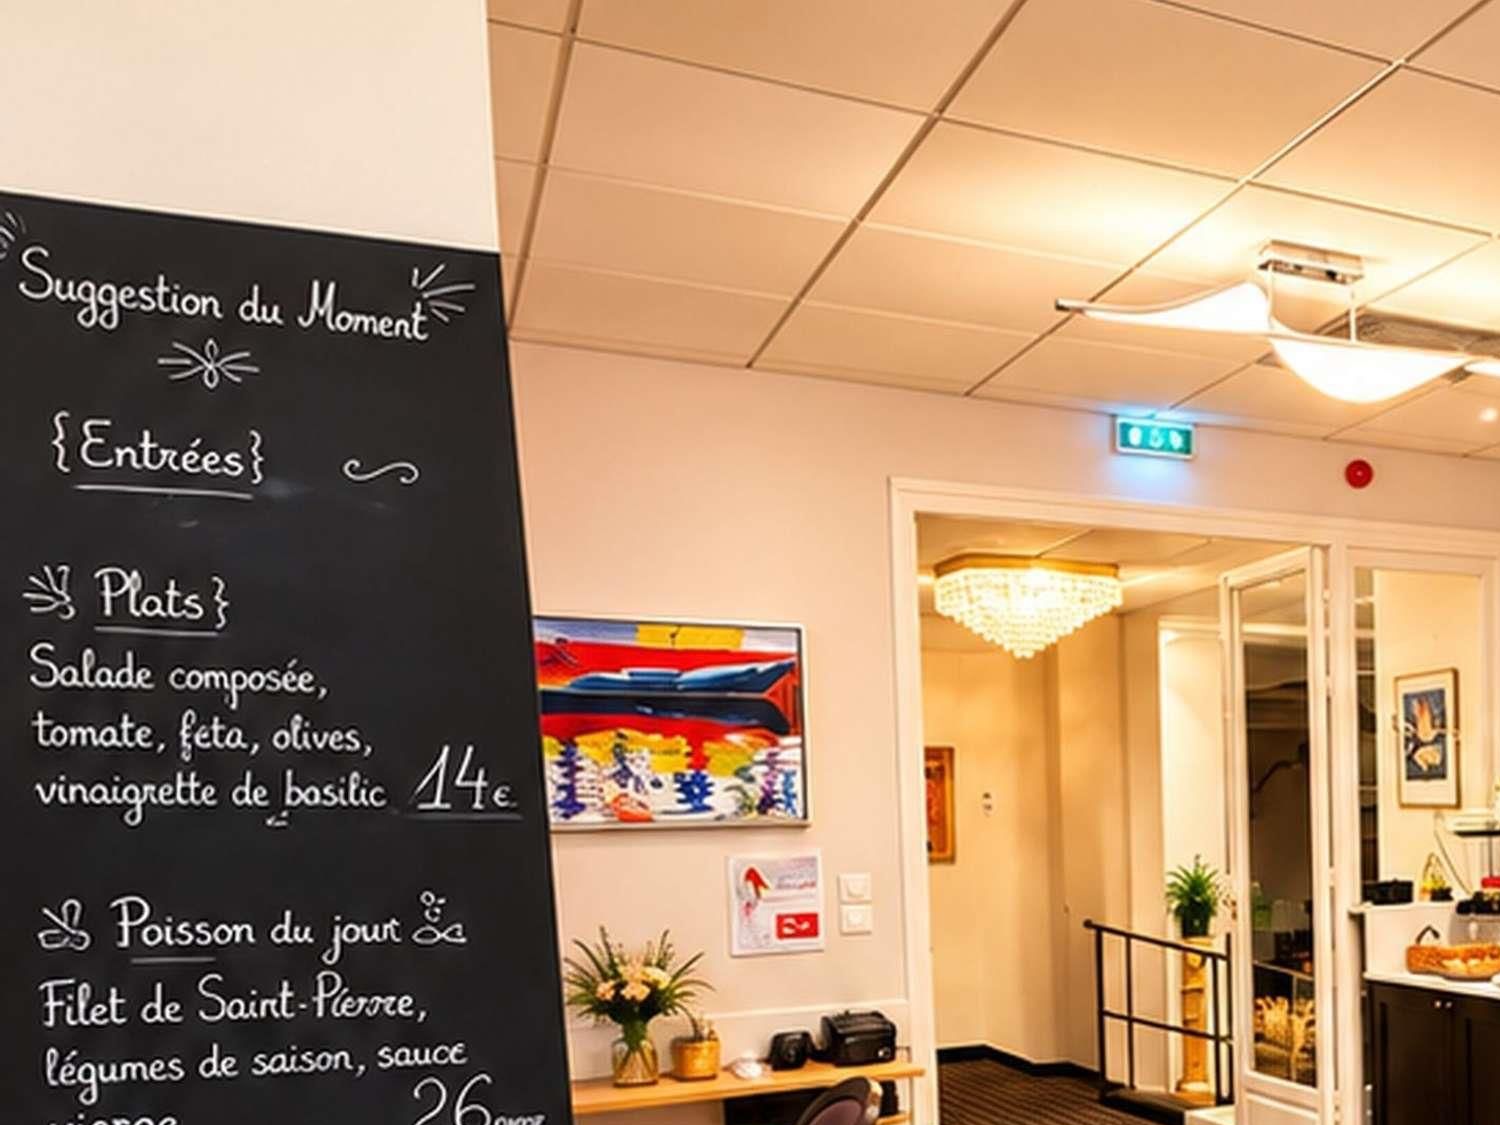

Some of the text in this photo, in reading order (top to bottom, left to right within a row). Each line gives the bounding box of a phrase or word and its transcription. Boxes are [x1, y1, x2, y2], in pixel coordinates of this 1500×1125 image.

[18, 246, 430, 341] Suggestion du Moment
[29, 642, 328, 710] Salade composée,
[31, 705, 372, 763] tomate, feta, olives,
[34, 771, 218, 827] vinaigrette
[231, 770, 270, 807] de
[284, 768, 387, 807] basilic
[110, 895, 402, 966] Poisson du jour
[38, 978, 127, 1028] Filet
[140, 982, 183, 1024] de
[46, 1042, 468, 1106] légumes de saison, sauce
